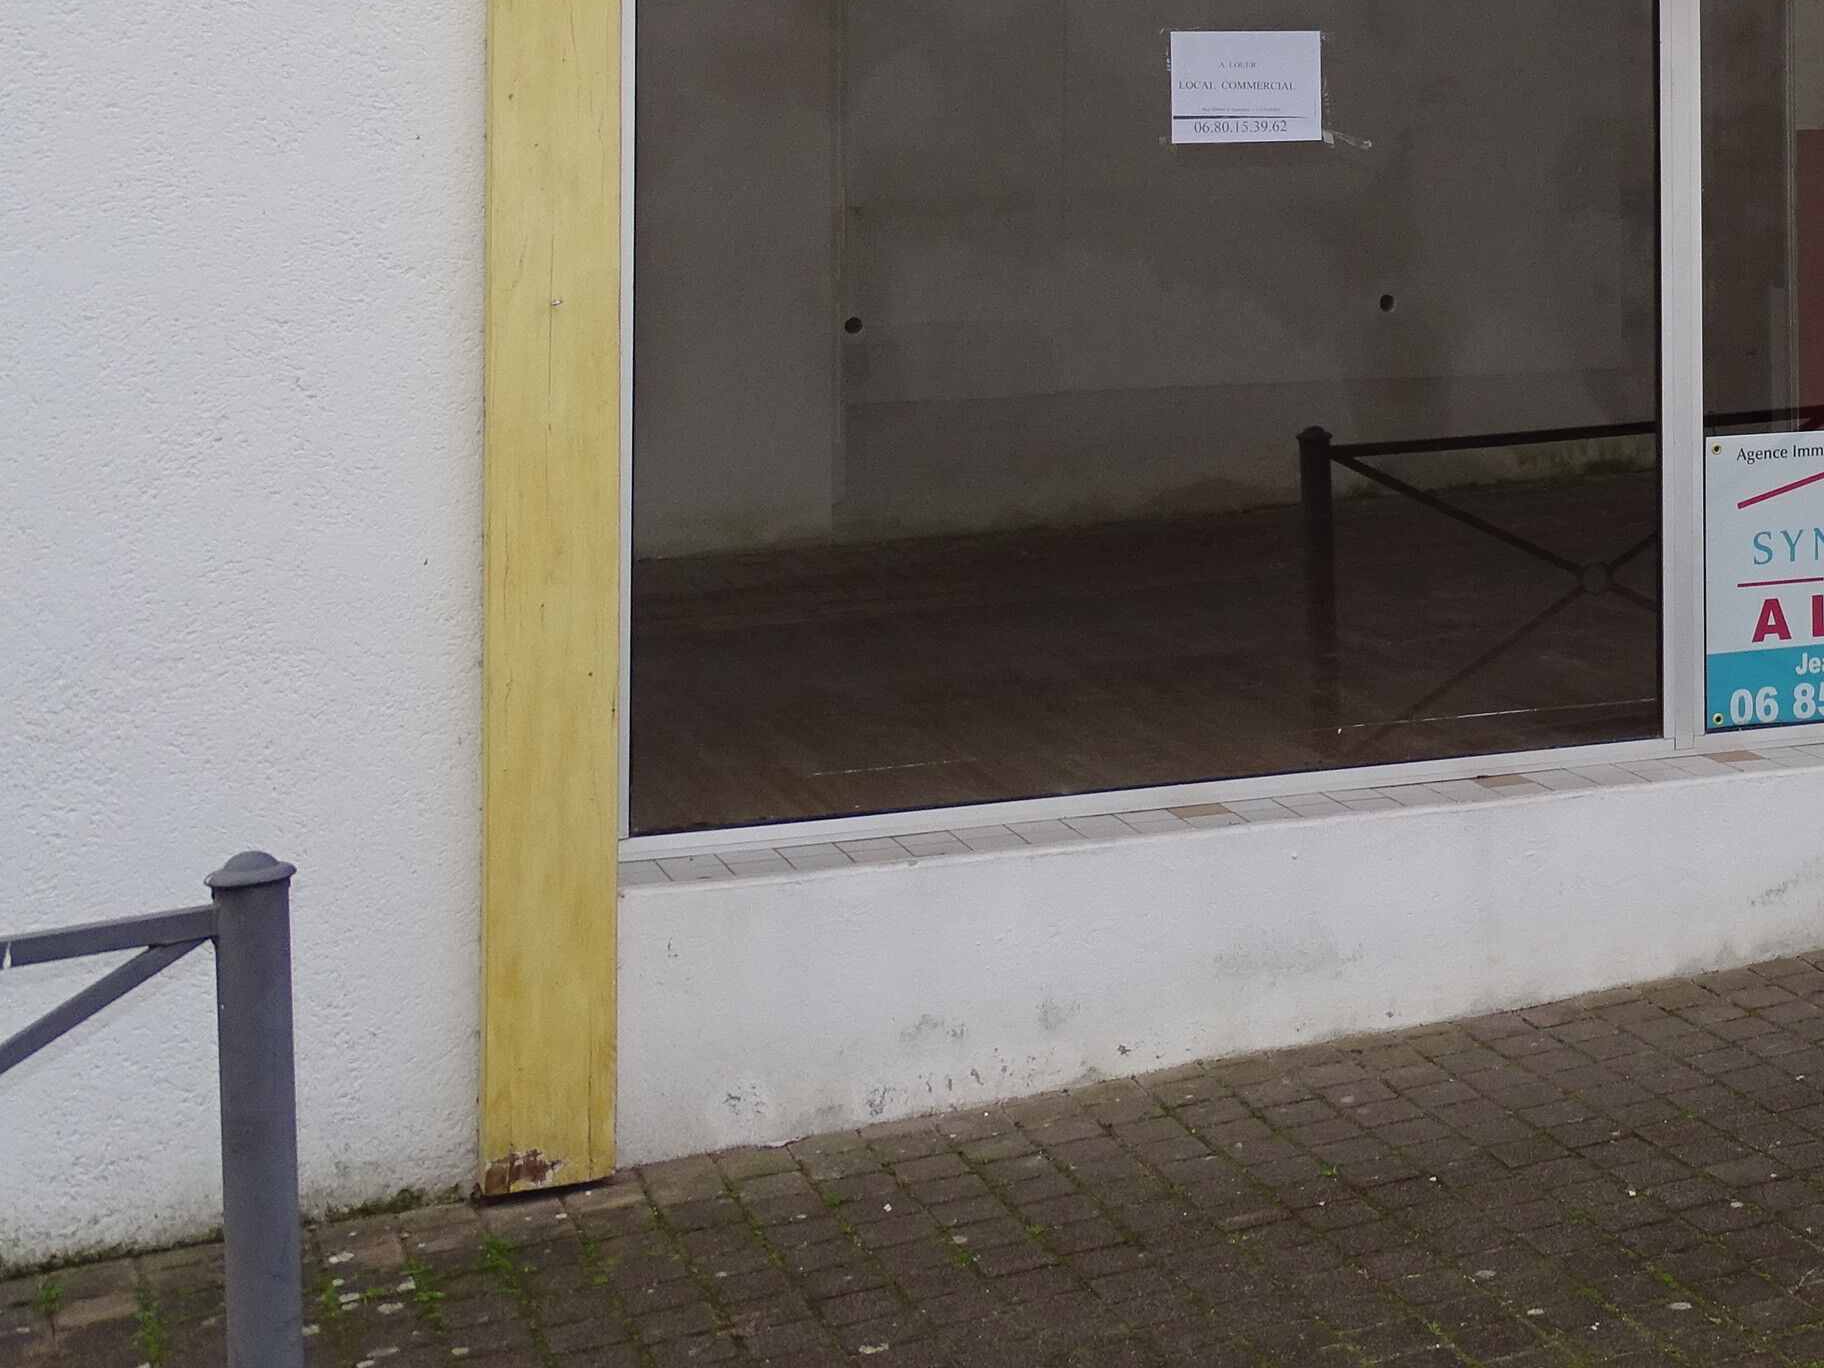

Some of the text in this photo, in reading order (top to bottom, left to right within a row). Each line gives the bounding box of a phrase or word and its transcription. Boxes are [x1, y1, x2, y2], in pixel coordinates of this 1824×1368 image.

[1178, 80, 1296, 91] LOCAL COMMERCIAL
[1194, 120, 1288, 134] 06.80.15.39.62
[1736, 445, 1788, 465] Agence
[1751, 598, 1792, 643] A
[1729, 686, 1779, 725] 06
